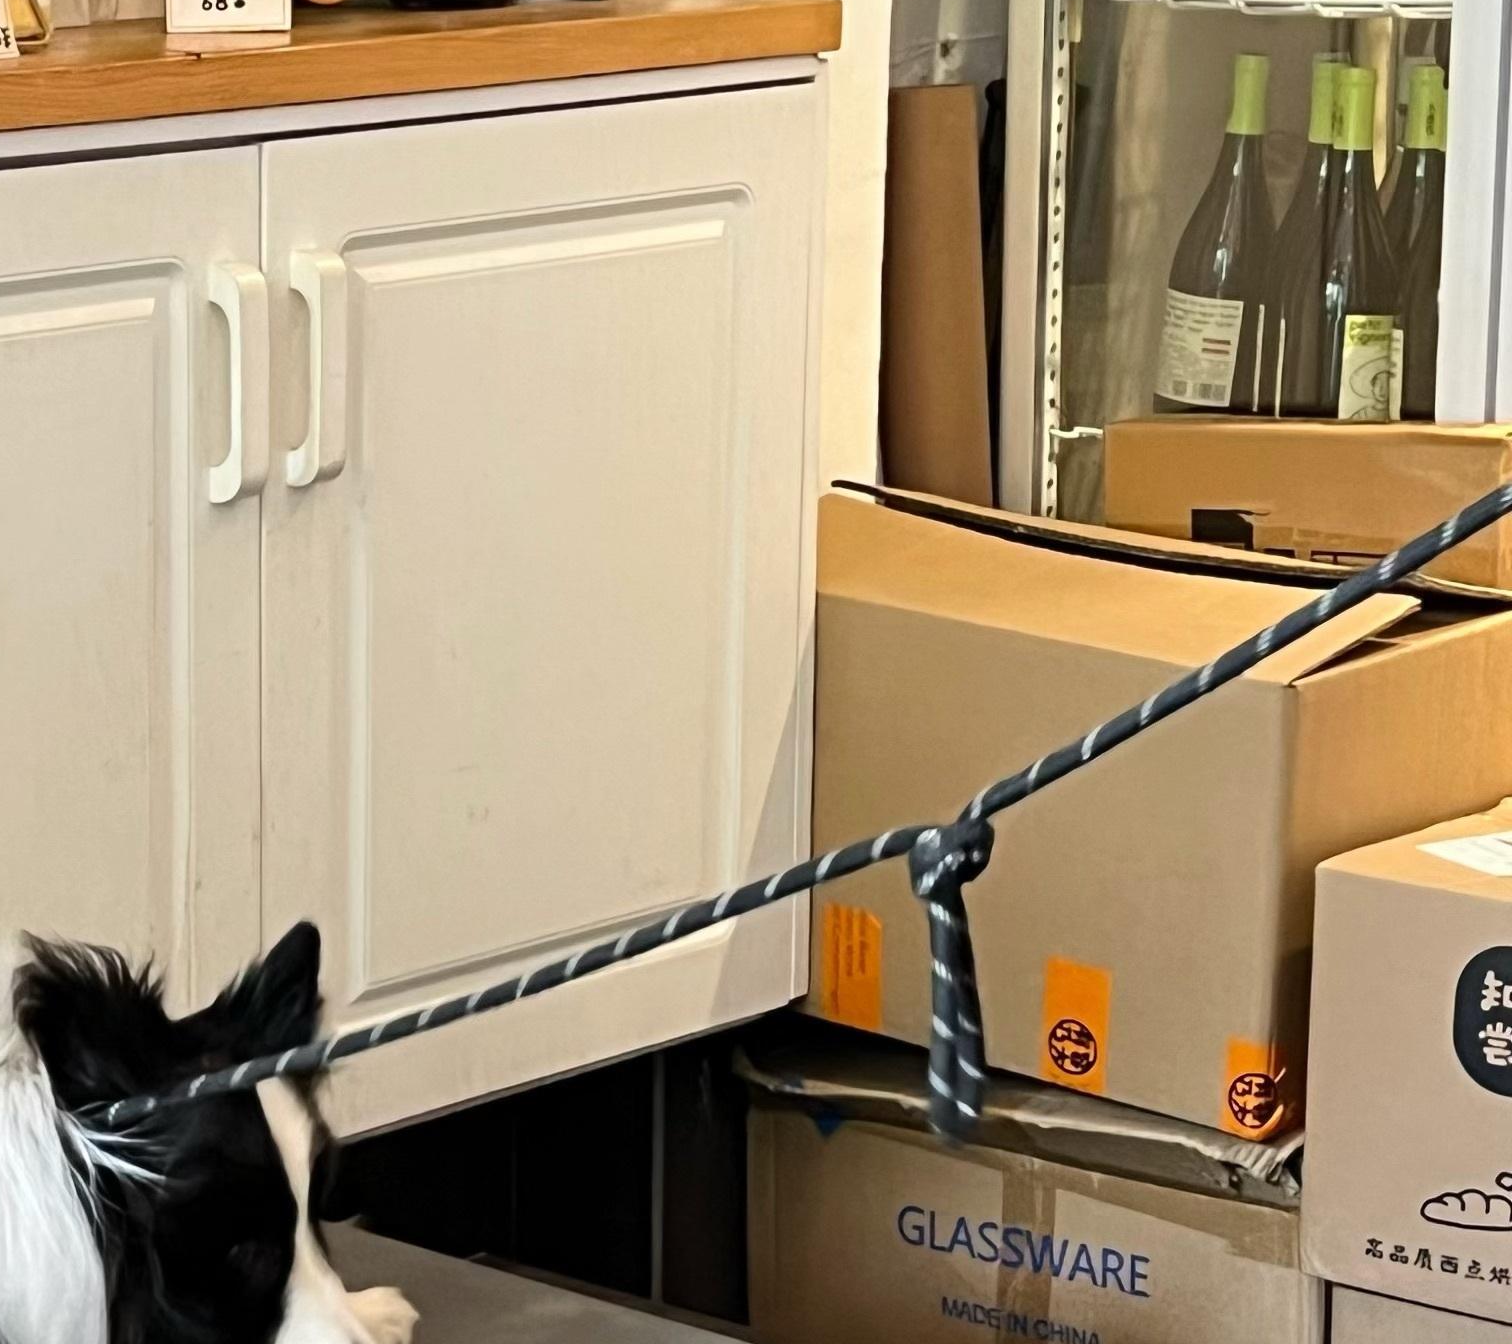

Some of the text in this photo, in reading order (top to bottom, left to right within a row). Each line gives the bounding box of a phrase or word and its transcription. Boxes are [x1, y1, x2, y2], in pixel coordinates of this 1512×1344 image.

[897, 1205, 1151, 1298] GLASSWARE
[941, 1296, 1001, 1331] MADE
[1005, 1313, 1029, 1337] IN
